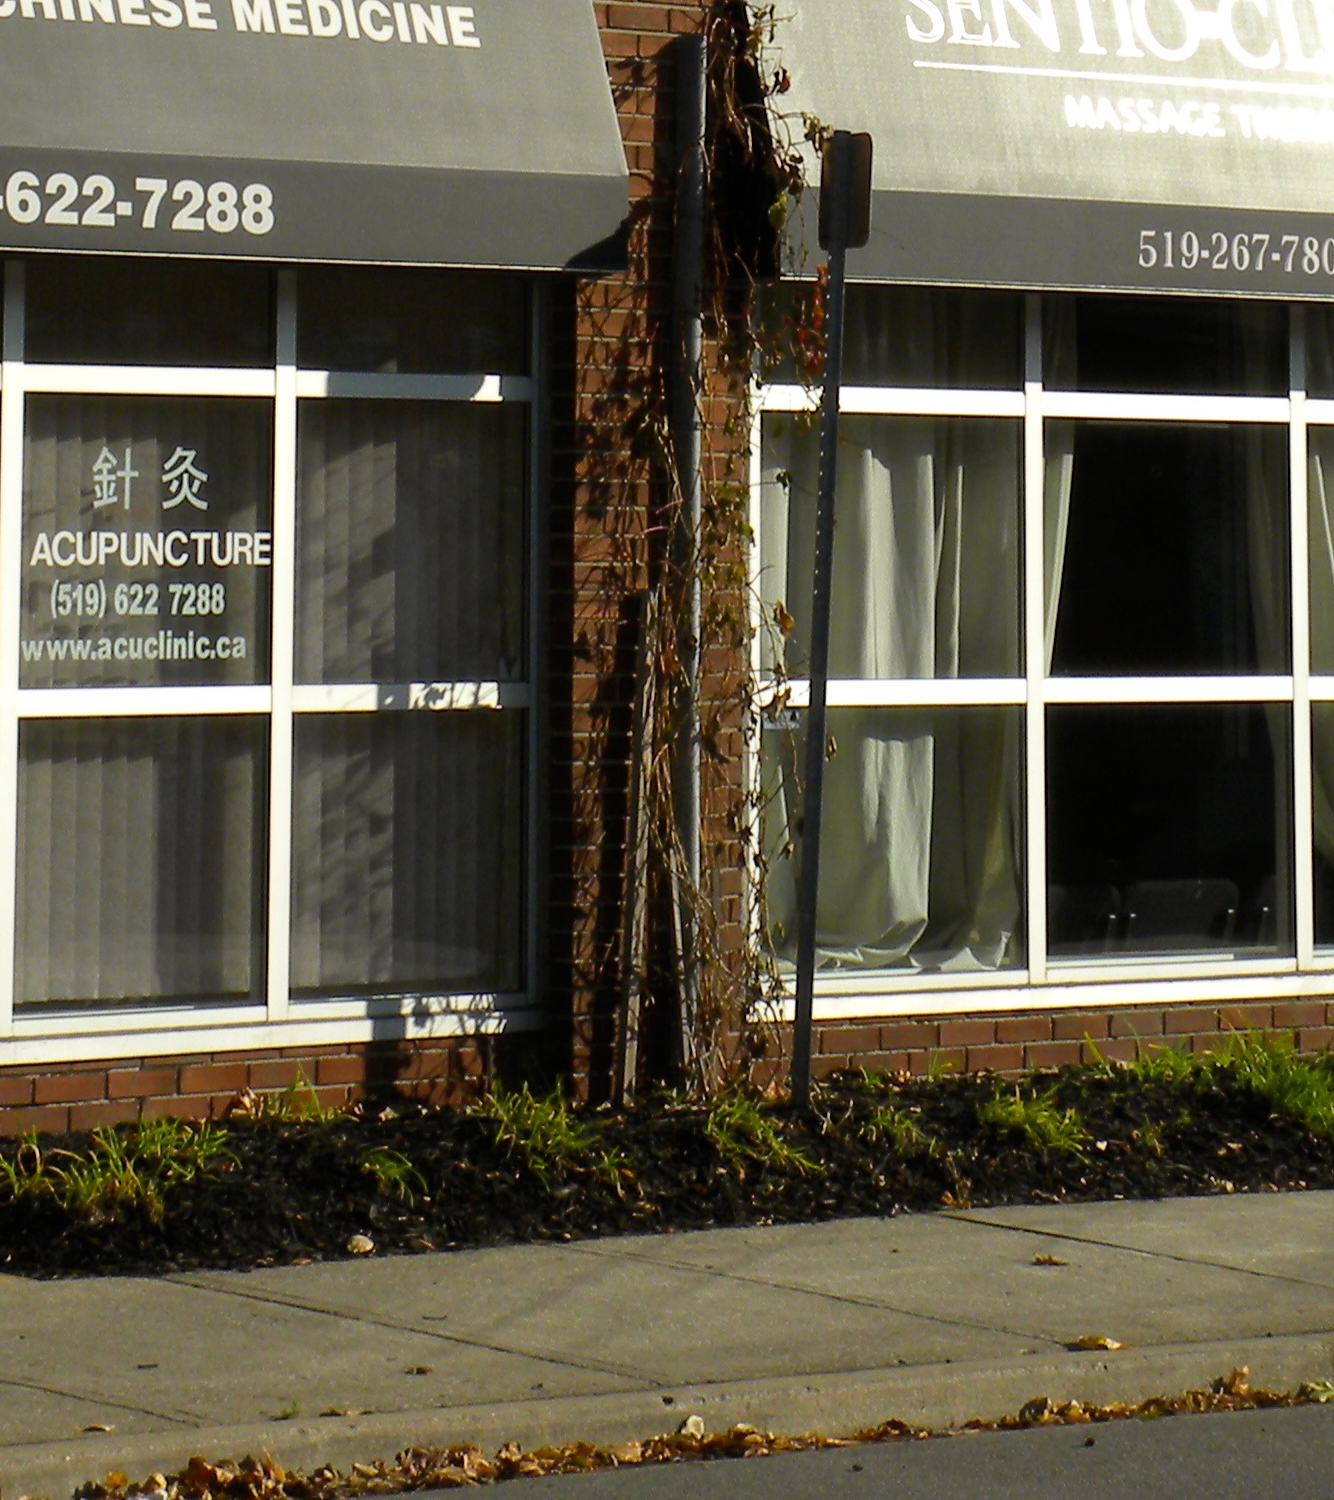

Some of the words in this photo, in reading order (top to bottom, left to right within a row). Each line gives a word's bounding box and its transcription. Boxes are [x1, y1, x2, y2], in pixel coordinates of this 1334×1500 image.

[1065, 95, 1226, 138] MASSAGE
[30, 530, 272, 567] ACUPUNCTURE
[50, 579, 107, 619] (519)
[114, 583, 160, 616] 622
[168, 583, 226, 616] 7288
[21, 629, 247, 661] www.acuclinic.ca
